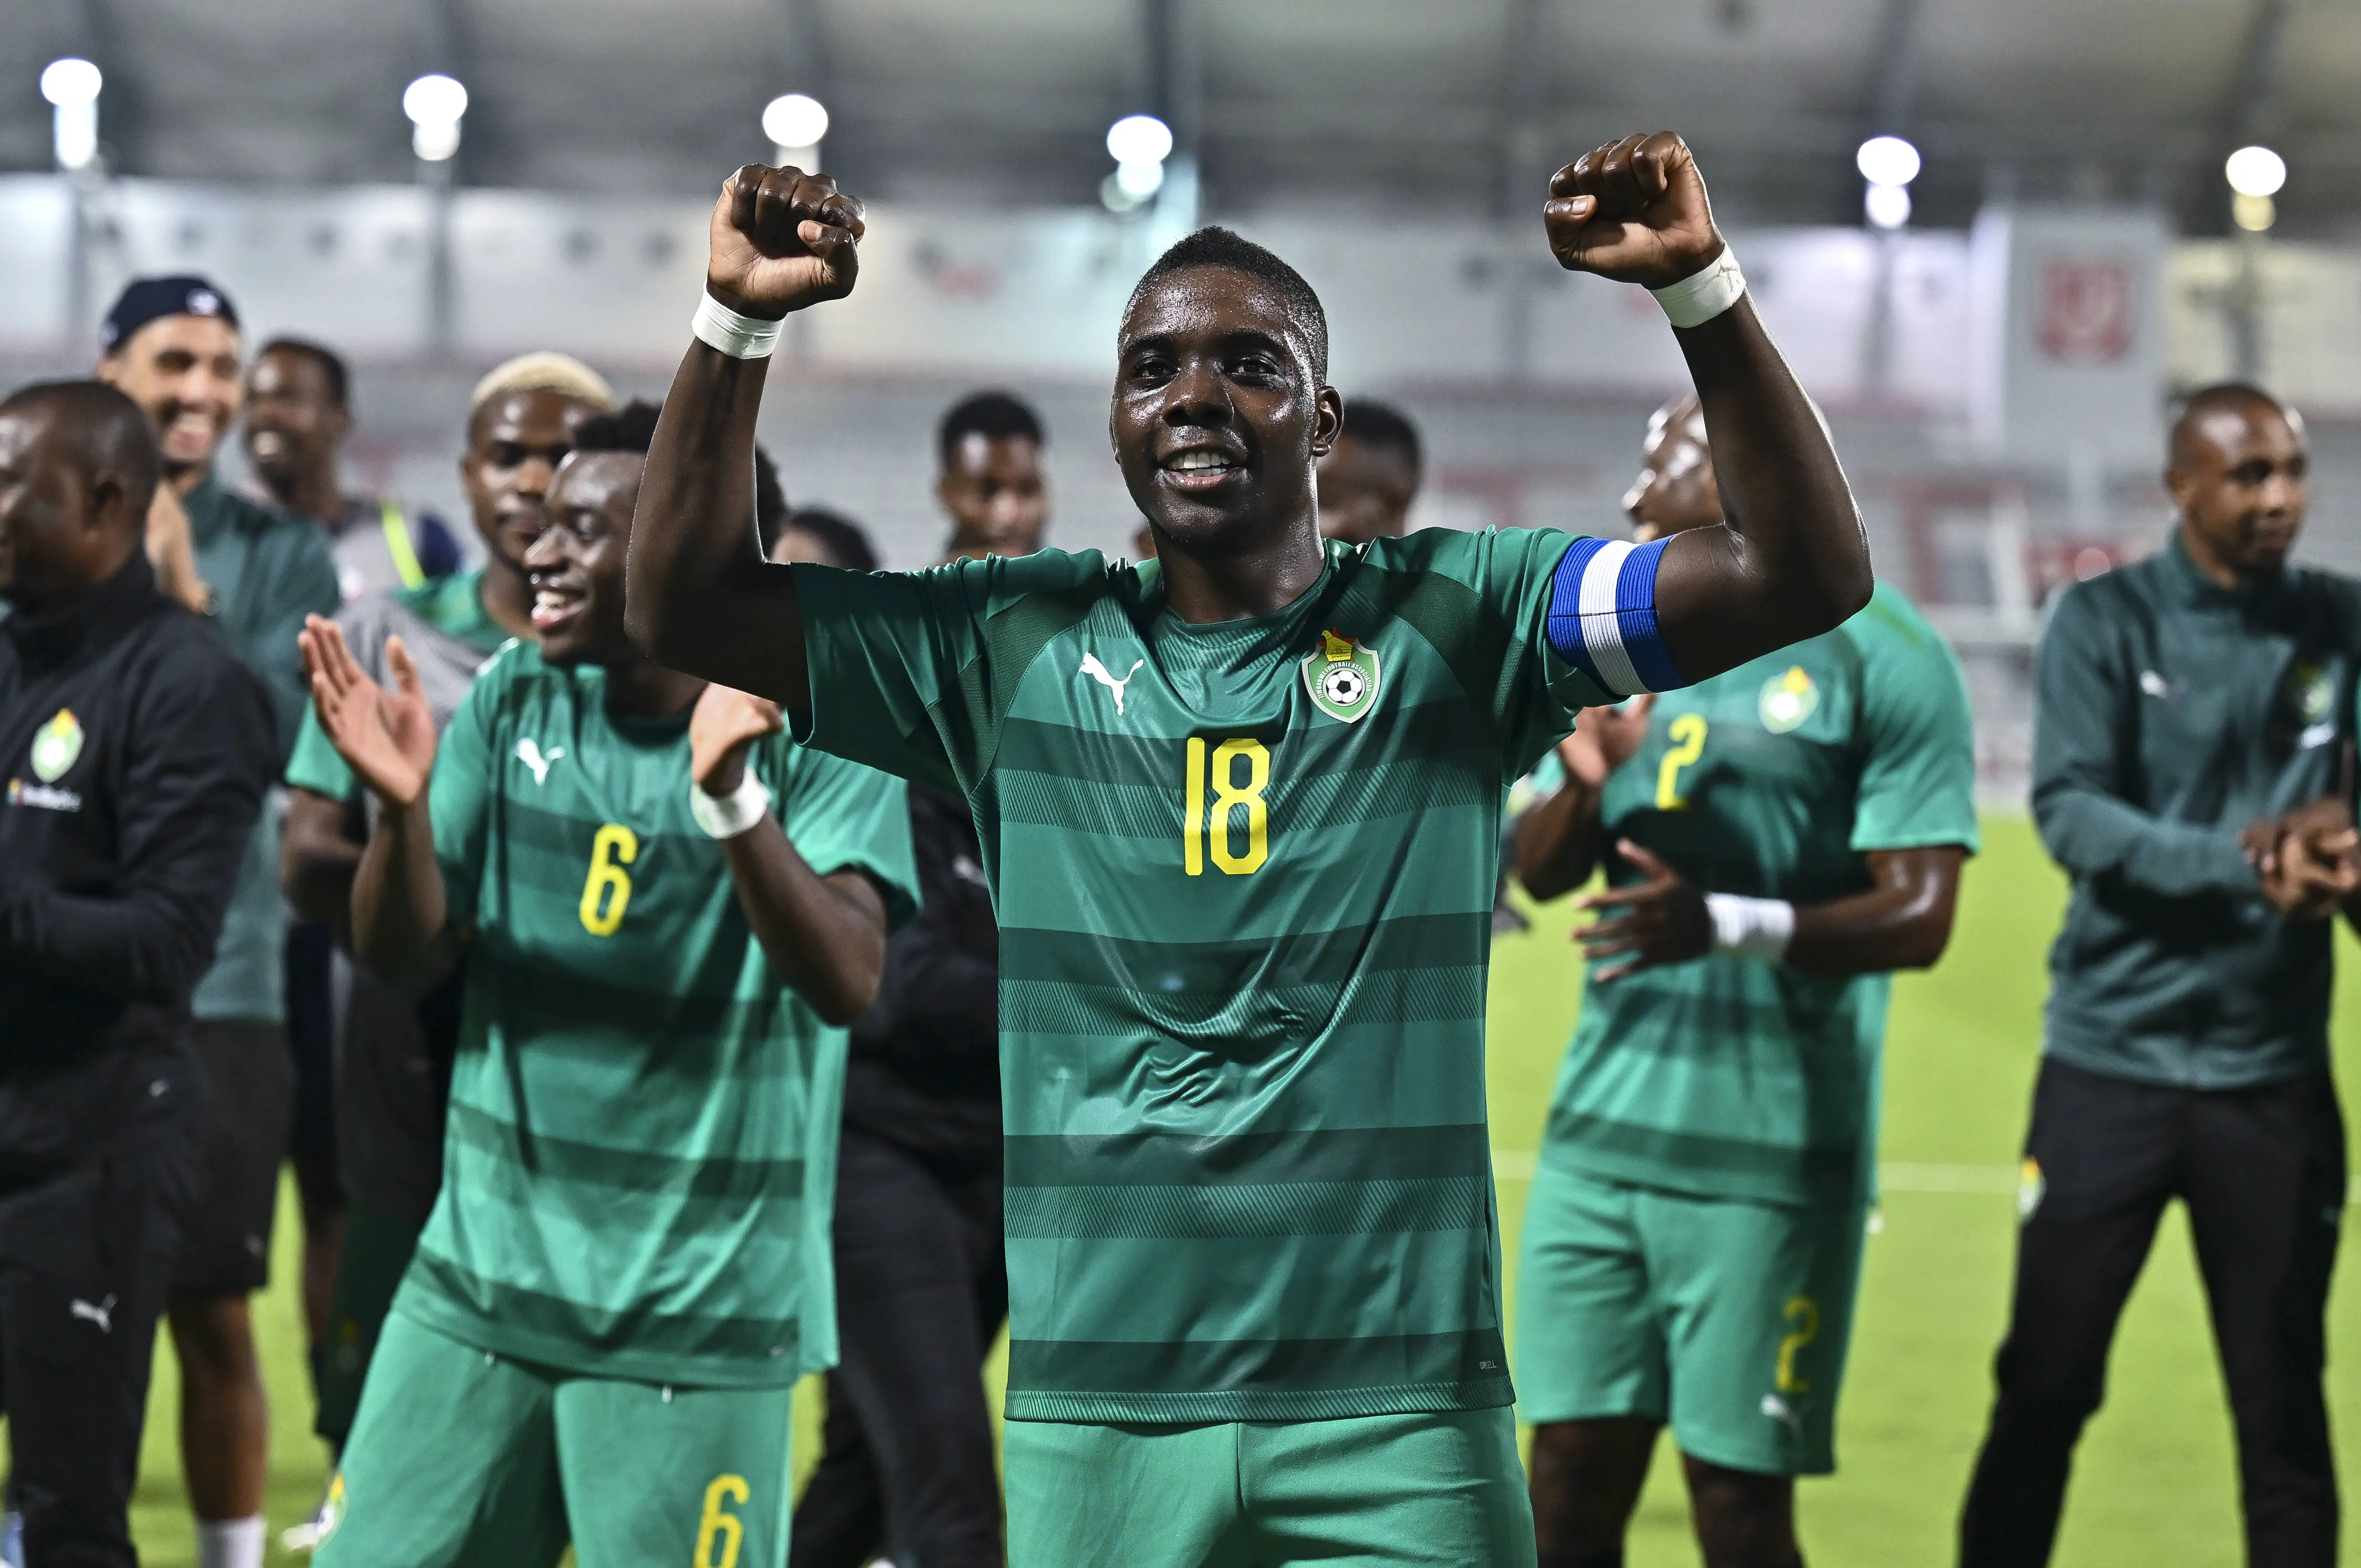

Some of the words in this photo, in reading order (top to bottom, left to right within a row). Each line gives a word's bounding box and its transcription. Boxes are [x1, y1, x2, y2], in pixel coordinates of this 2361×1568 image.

[1316, 670, 1327, 699] ZIMBABWE
[1325, 661, 1351, 672] FOOTBALL
[1351, 663, 1372, 692] ASSOCIATION
[1184, 737, 1270, 876] 18
[1655, 712, 1708, 810] 2
[579, 823, 638, 938] 6
[1775, 1295, 1820, 1392] 2
[693, 1474, 750, 1568] 6
